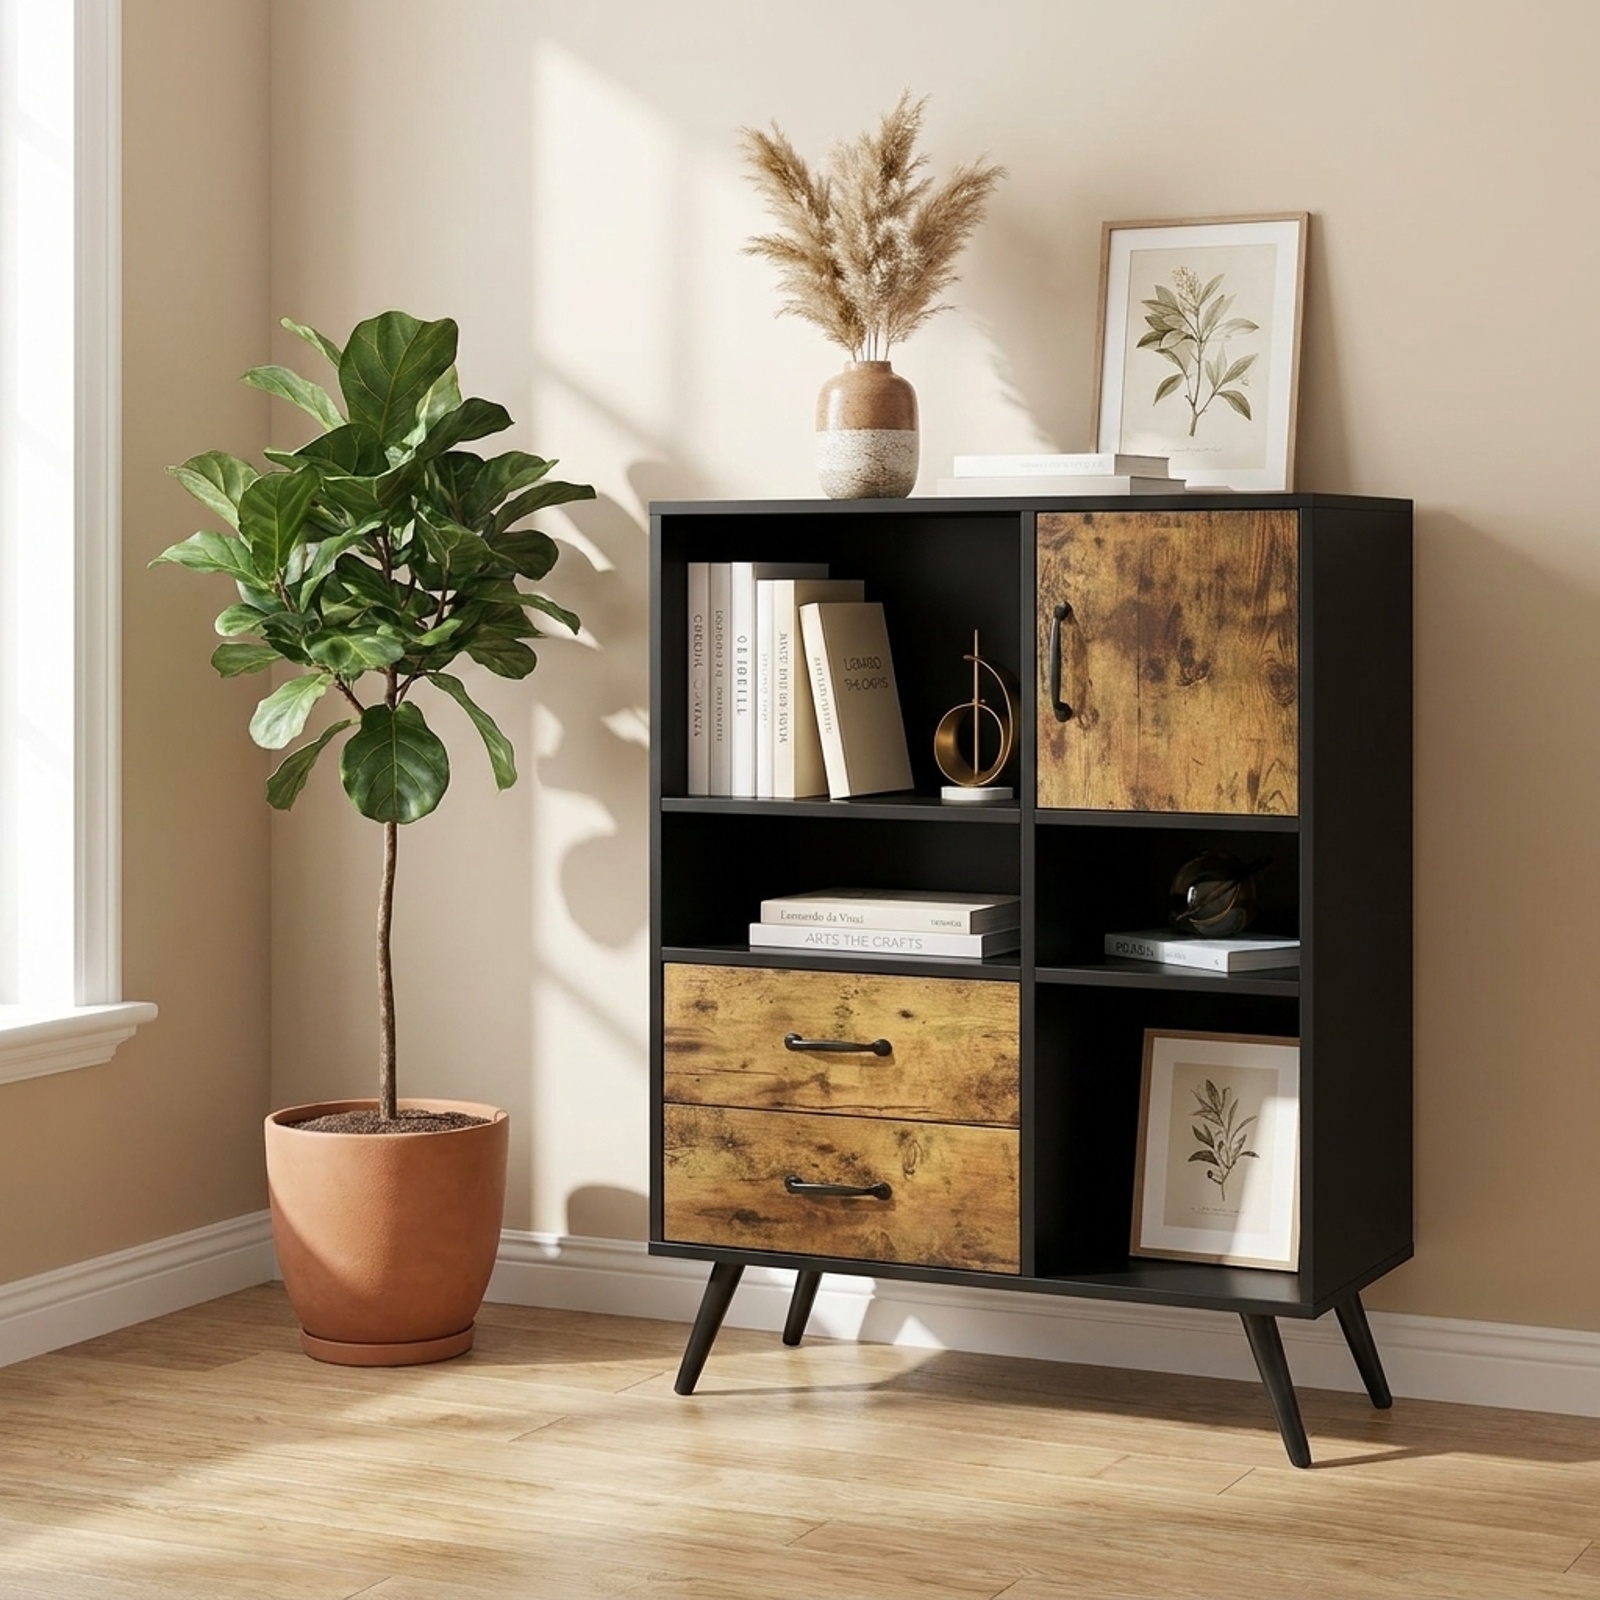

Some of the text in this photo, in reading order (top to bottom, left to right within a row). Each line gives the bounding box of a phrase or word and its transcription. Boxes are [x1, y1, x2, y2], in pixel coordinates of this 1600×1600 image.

[826, 911, 837, 923] da
[805, 932, 923, 949] ARTS THE CRAFTS
